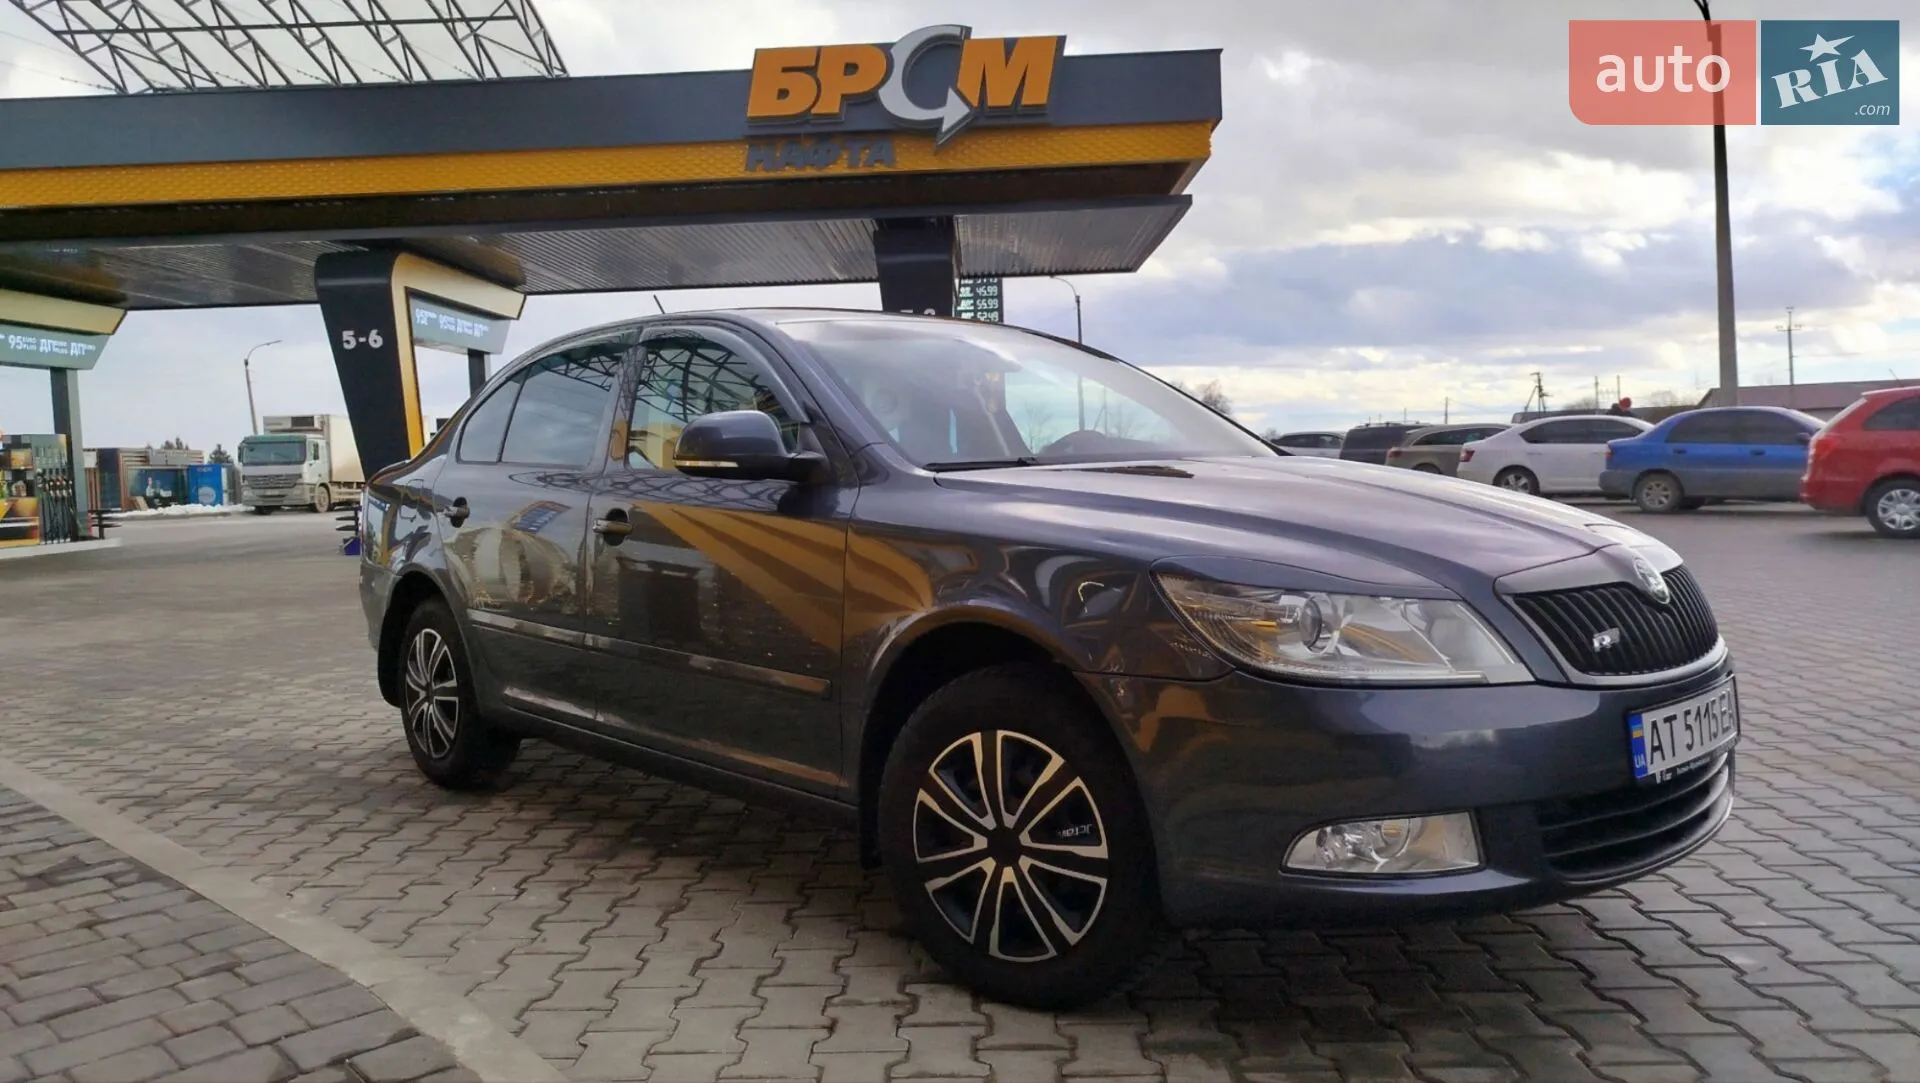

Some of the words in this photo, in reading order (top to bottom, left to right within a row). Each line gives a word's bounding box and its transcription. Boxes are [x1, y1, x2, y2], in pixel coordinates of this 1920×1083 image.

[747, 25, 1060, 140] БРСМ
[745, 137, 896, 172] НАФТА
[976, 285, 998, 296] 45.99
[976, 298, 999, 310] 55.99
[8, 335, 23, 350] 95
[342, 329, 383, 350] 5-6
[1649, 713, 1678, 765] AT
[1683, 697, 1720, 752] 5115
[1633, 753, 1647, 769] UA
